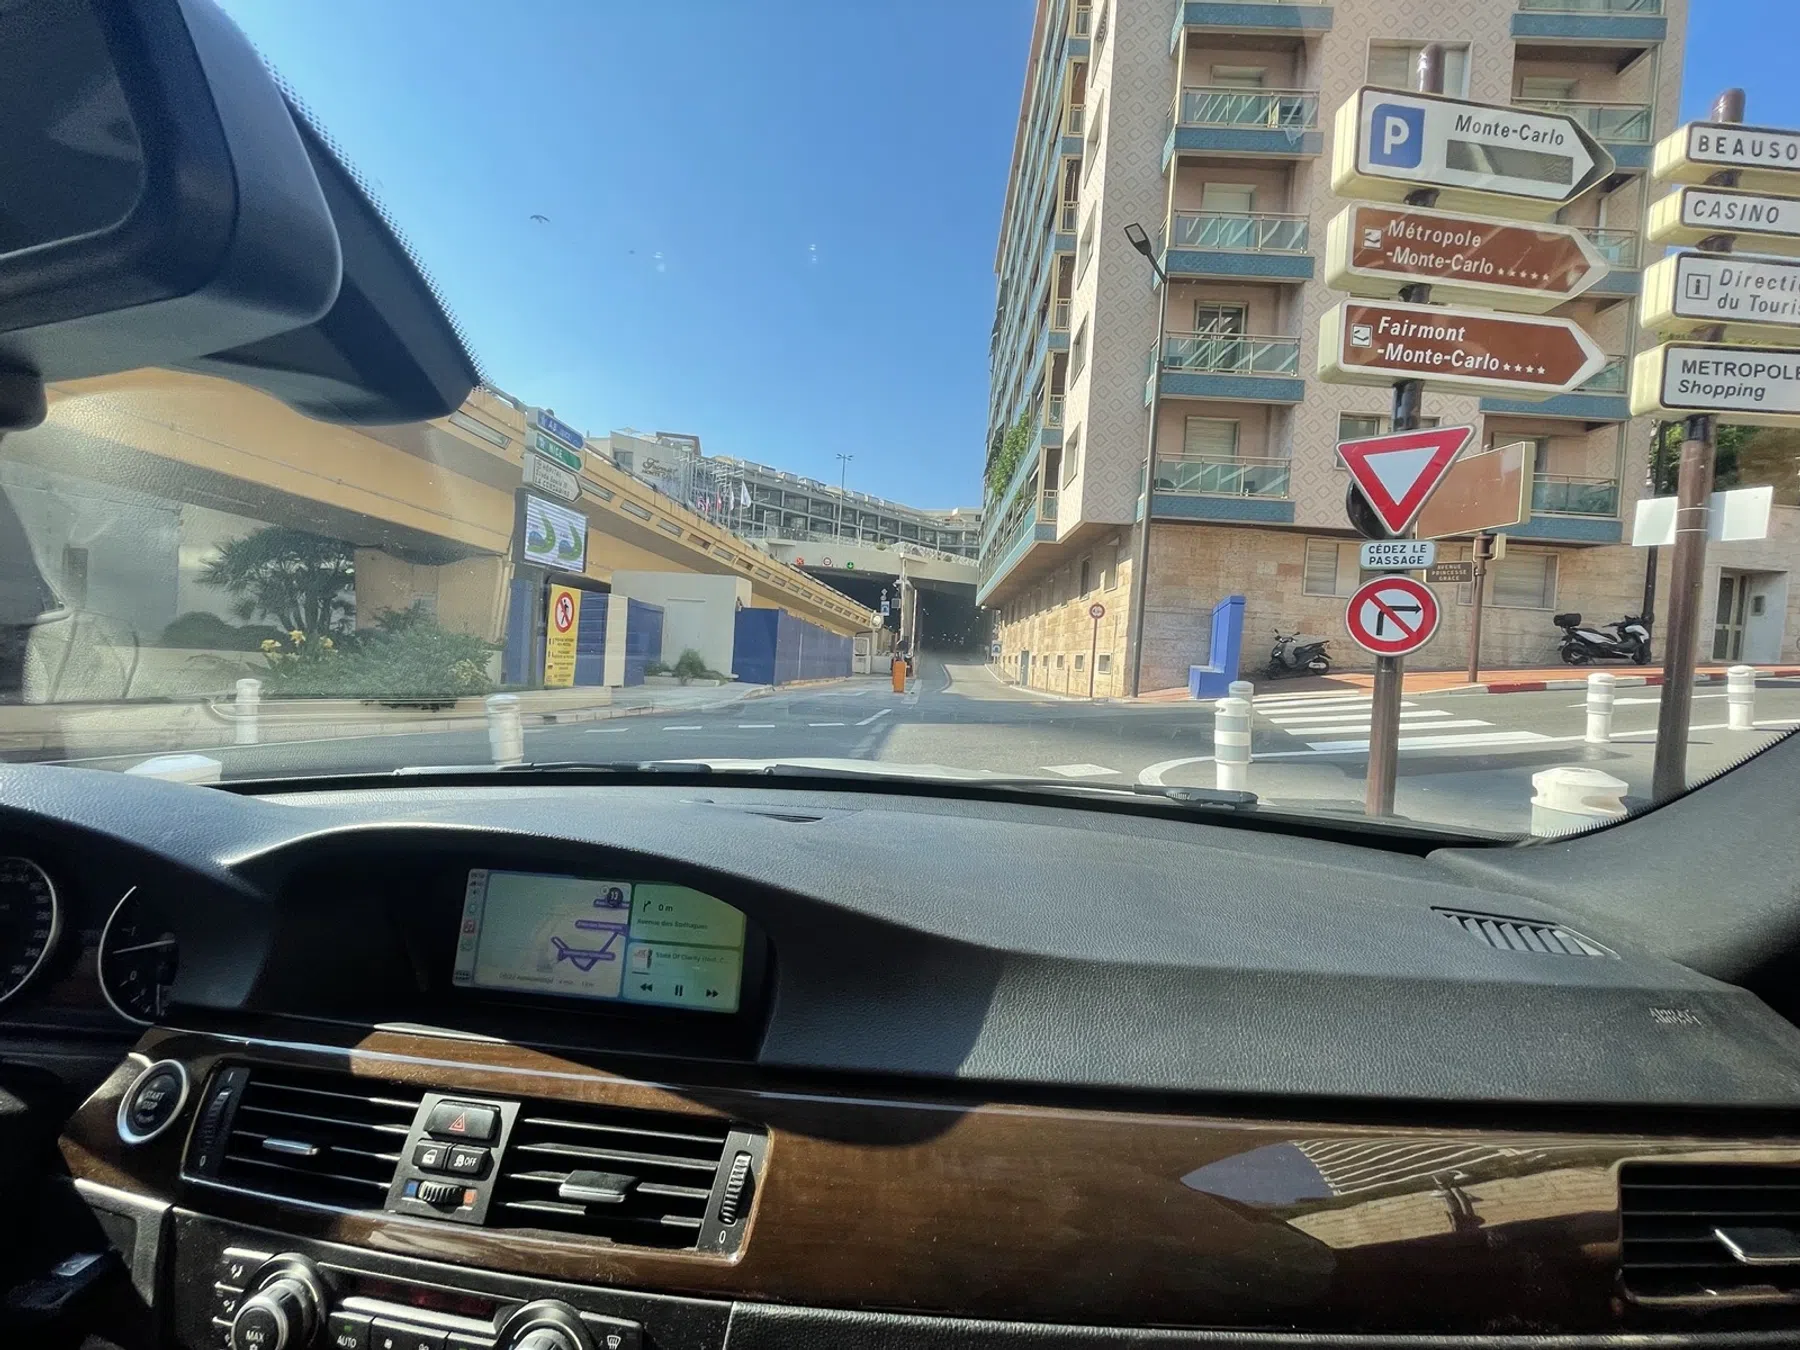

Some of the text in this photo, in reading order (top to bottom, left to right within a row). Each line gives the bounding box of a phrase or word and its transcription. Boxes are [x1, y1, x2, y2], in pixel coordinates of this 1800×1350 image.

[1384, 116, 1410, 155] P
[1454, 114, 1565, 147] Monte-Carlo
[1693, 199, 1780, 224] CASINO
[1387, 220, 1482, 248] Métropole
[1386, 246, 1494, 276] -Monte-Carlo
[1719, 268, 1800, 294] Directi
[1717, 293, 1740, 310] du
[1378, 316, 1467, 343] Fairmont
[1376, 343, 1500, 372] -Monte-Carlo
[1678, 379, 1766, 402] Shopping
[1368, 543, 1427, 554] CÉDEZ LE
[1369, 555, 1425, 565] PASSAGE
[464, 1156, 478, 1167] OFF
[245, 1329, 265, 1344] MAX
[336, 1334, 358, 1349] AUTO
